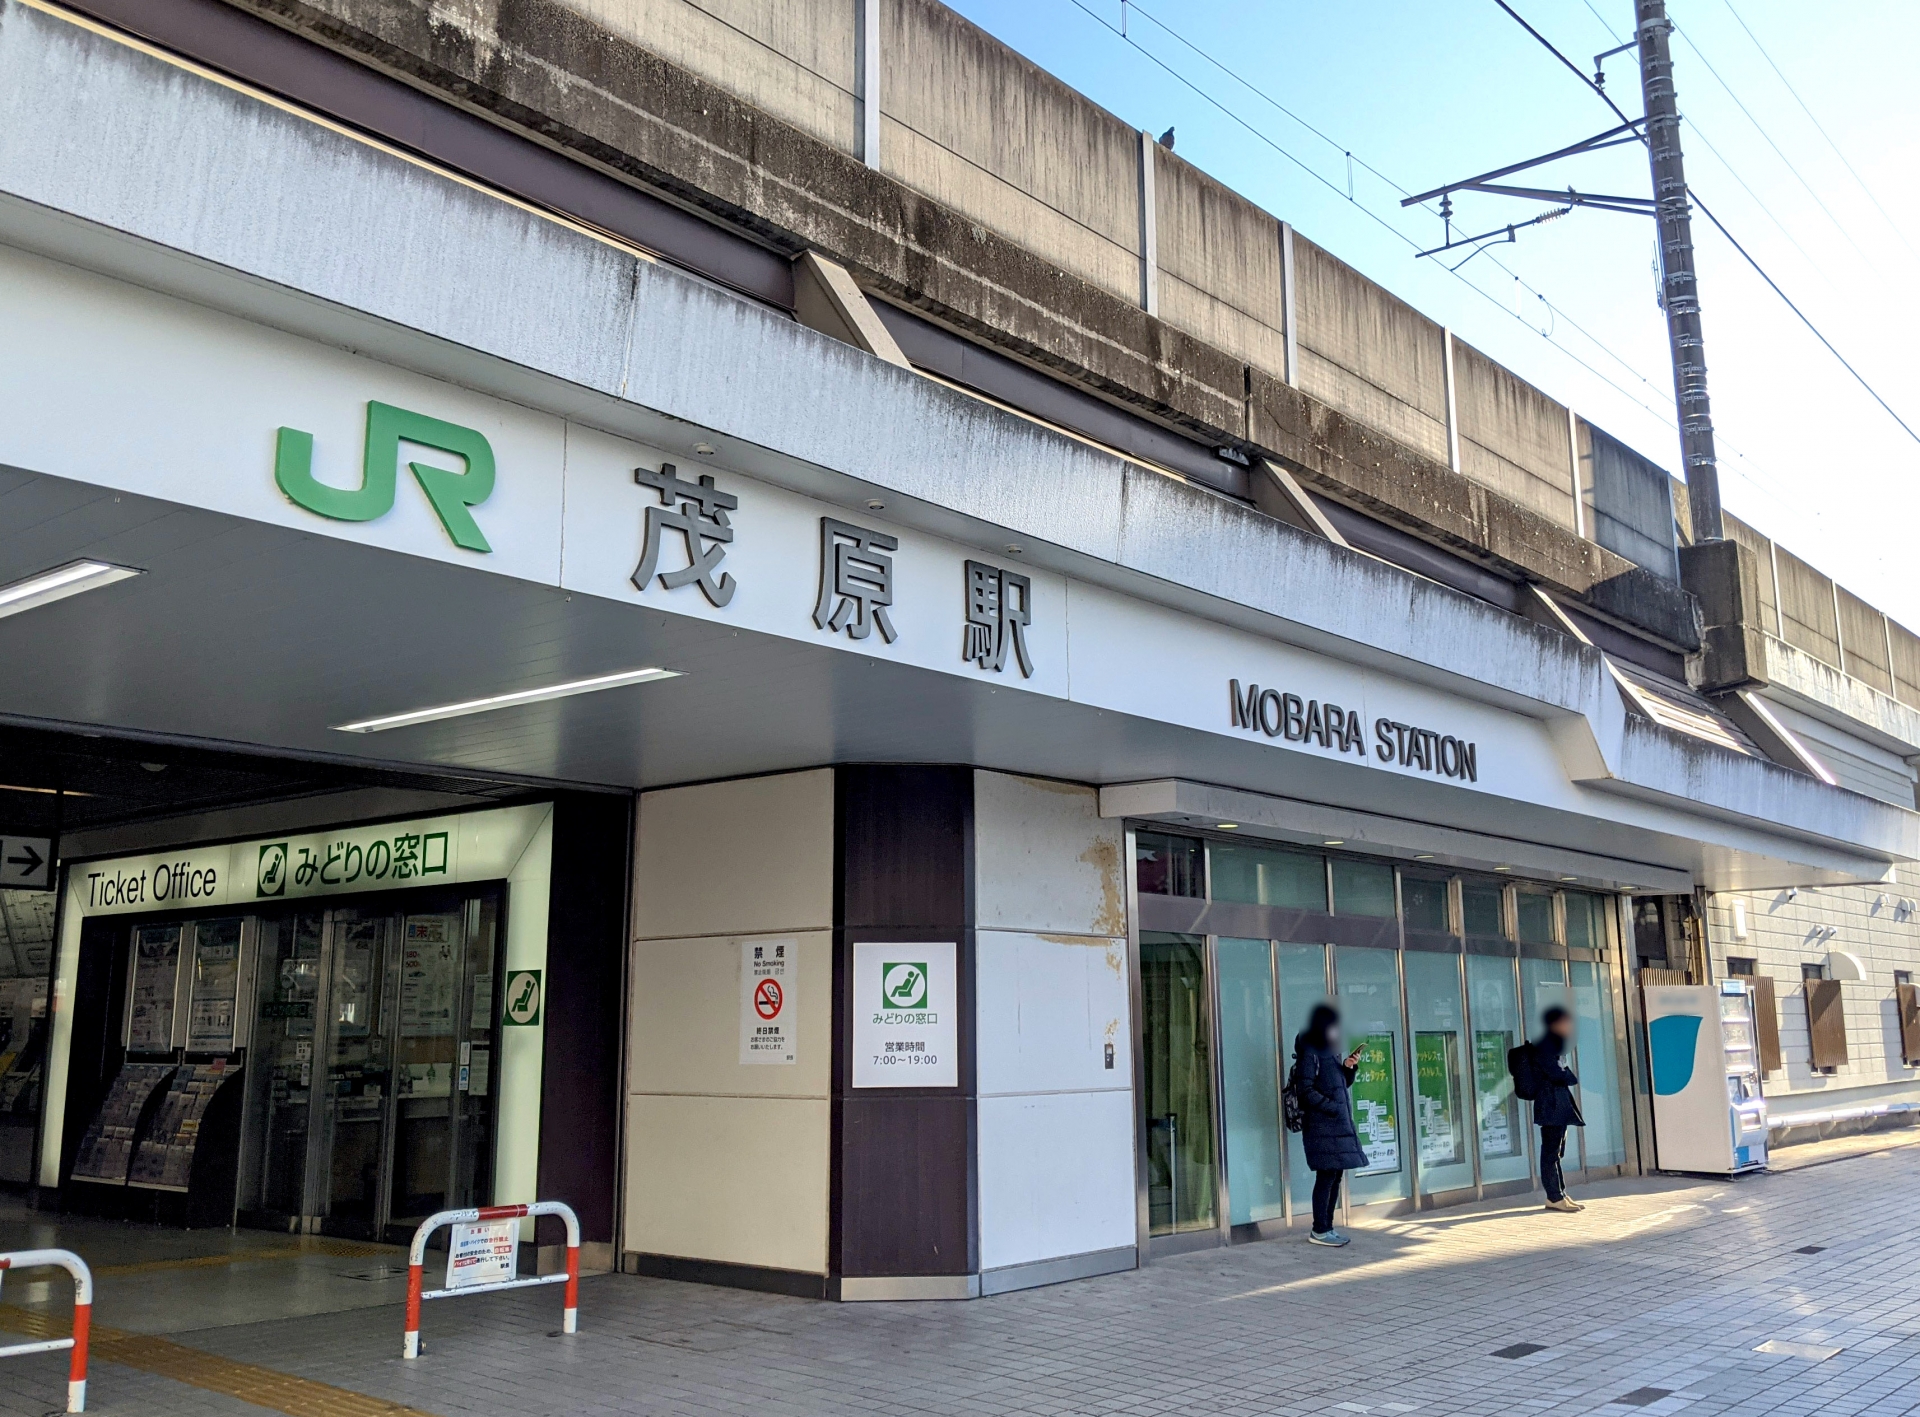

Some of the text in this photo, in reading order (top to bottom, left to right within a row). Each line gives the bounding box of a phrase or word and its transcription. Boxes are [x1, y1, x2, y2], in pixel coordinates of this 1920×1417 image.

[275, 400, 496, 554] JR
[630, 462, 1035, 679] 茂原駅
[1229, 678, 1478, 783] MOBARA STATION
[295, 831, 448, 887] みどりの窓口
[88, 862, 216, 907] Ticket Office
[754, 945, 785, 959] 禁煙
[873, 1013, 938, 1025] みどりの窓口
[884, 1041, 926, 1052] 営業時間
